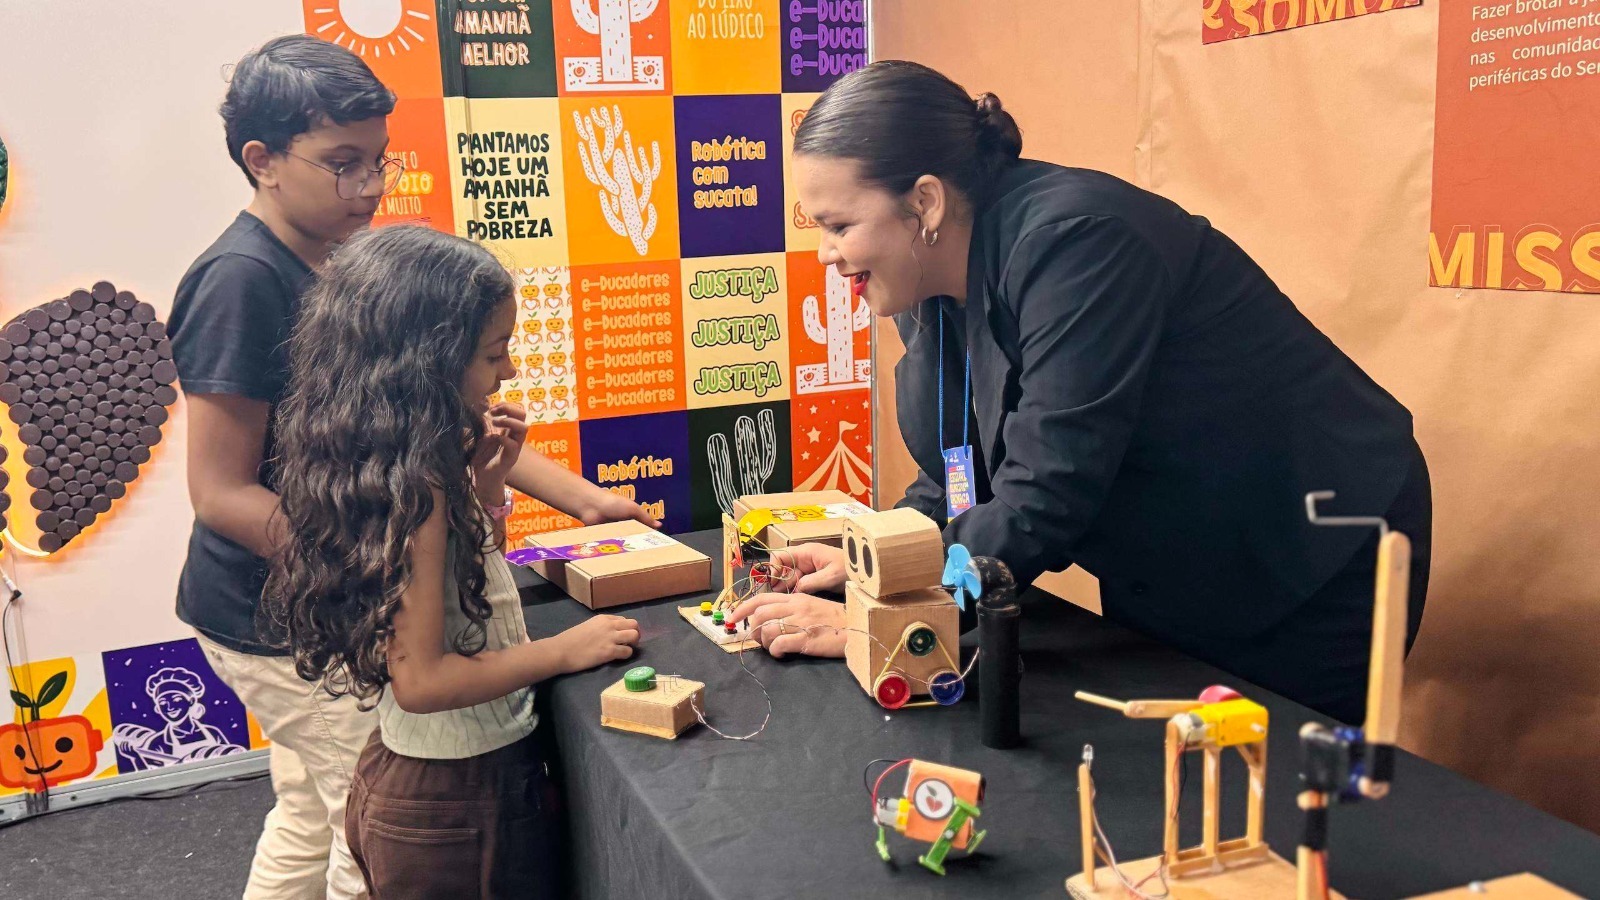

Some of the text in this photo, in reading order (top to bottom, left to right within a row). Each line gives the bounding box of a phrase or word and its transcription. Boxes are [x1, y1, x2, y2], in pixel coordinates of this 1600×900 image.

[454, 3, 532, 35] AMANHÃ
[687, 9, 764, 40] AO LÚDICO
[1472, 2, 1513, 21] Fazer
[1470, 51, 1496, 66] nas
[1469, 66, 1548, 92] periféricas
[1550, 61, 1572, 79] do
[691, 135, 766, 162] Robótica
[461, 156, 549, 177] HOJE UM
[692, 165, 729, 186] com
[463, 173, 550, 199] AMANHÃ
[693, 184, 758, 209] sucata!
[385, 195, 422, 215] MUITO
[483, 200, 529, 219] SEM
[466, 217, 553, 240] POBREZA
[689, 266, 779, 304] JUSTIÇA
[692, 313, 780, 351] JUSTIÇA
[694, 360, 782, 397] JUSTIÇA
[597, 455, 674, 484] Robótica
